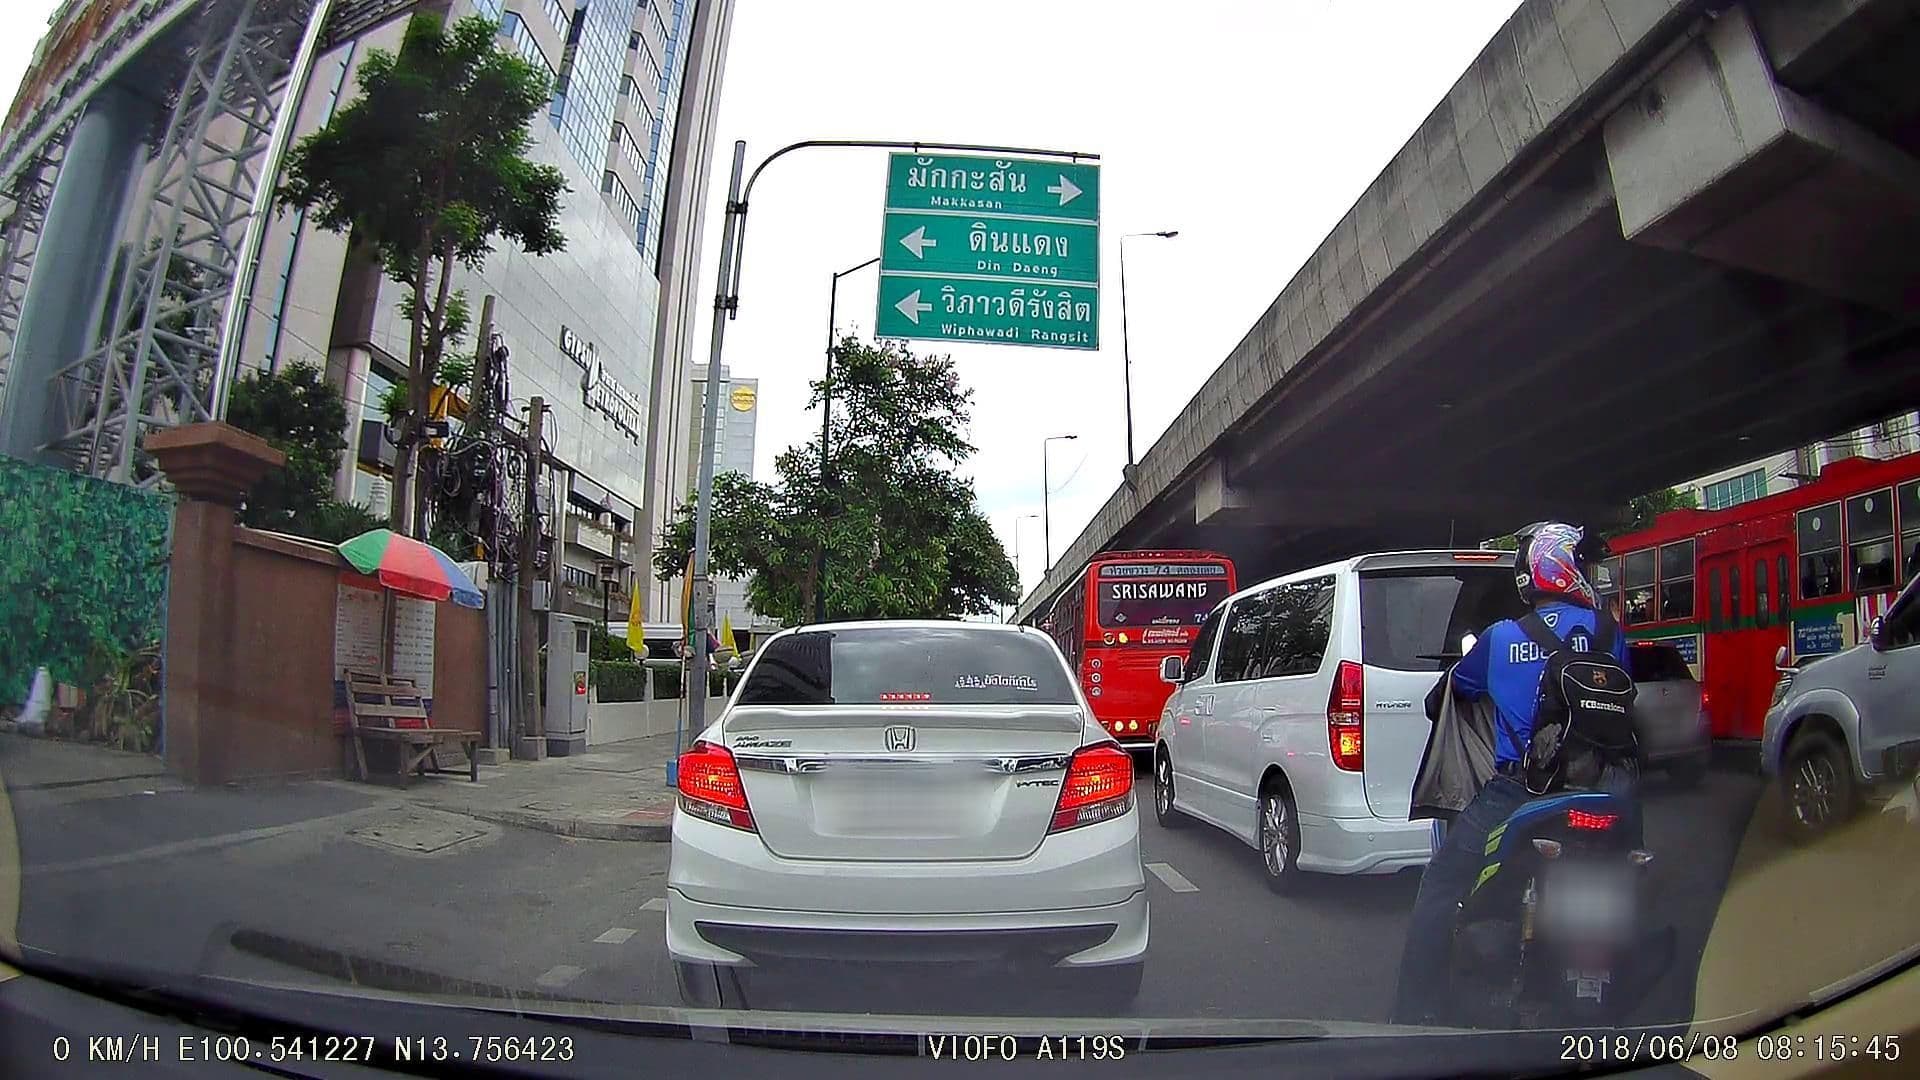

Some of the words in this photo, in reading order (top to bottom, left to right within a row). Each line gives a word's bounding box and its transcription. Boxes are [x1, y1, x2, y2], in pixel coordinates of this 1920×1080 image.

[908, 157, 1027, 193] มักกะสัน
[931, 195, 1003, 209] Makkasan
[969, 222, 1068, 257] ดินแดง
[977, 260, 1001, 272] Din
[1013, 262, 1058, 277] Daeng
[941, 285, 1091, 322] วิภาวดีรังสิต
[941, 323, 1020, 338] Wiphawadi
[1031, 329, 1089, 344] Rangsit
[1112, 583, 1207, 599] SRISAWANG
